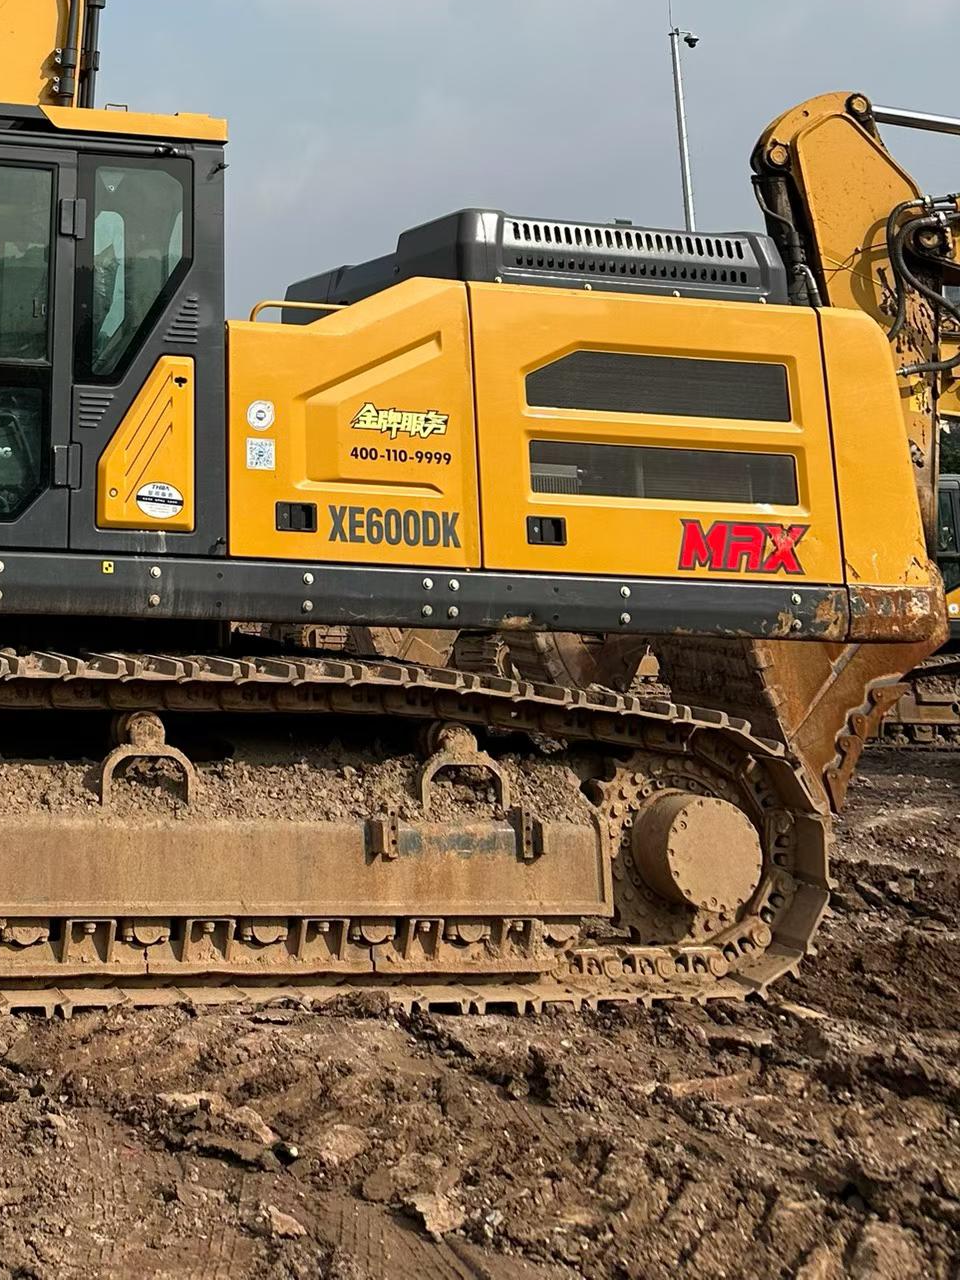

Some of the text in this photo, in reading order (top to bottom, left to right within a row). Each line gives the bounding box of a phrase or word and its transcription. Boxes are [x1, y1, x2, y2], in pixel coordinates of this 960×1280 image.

[350, 402, 449, 440] 金牌服务
[350, 447, 452, 465] 400-110-9999
[328, 505, 461, 548] XE600DK
[678, 519, 811, 575] MAX
